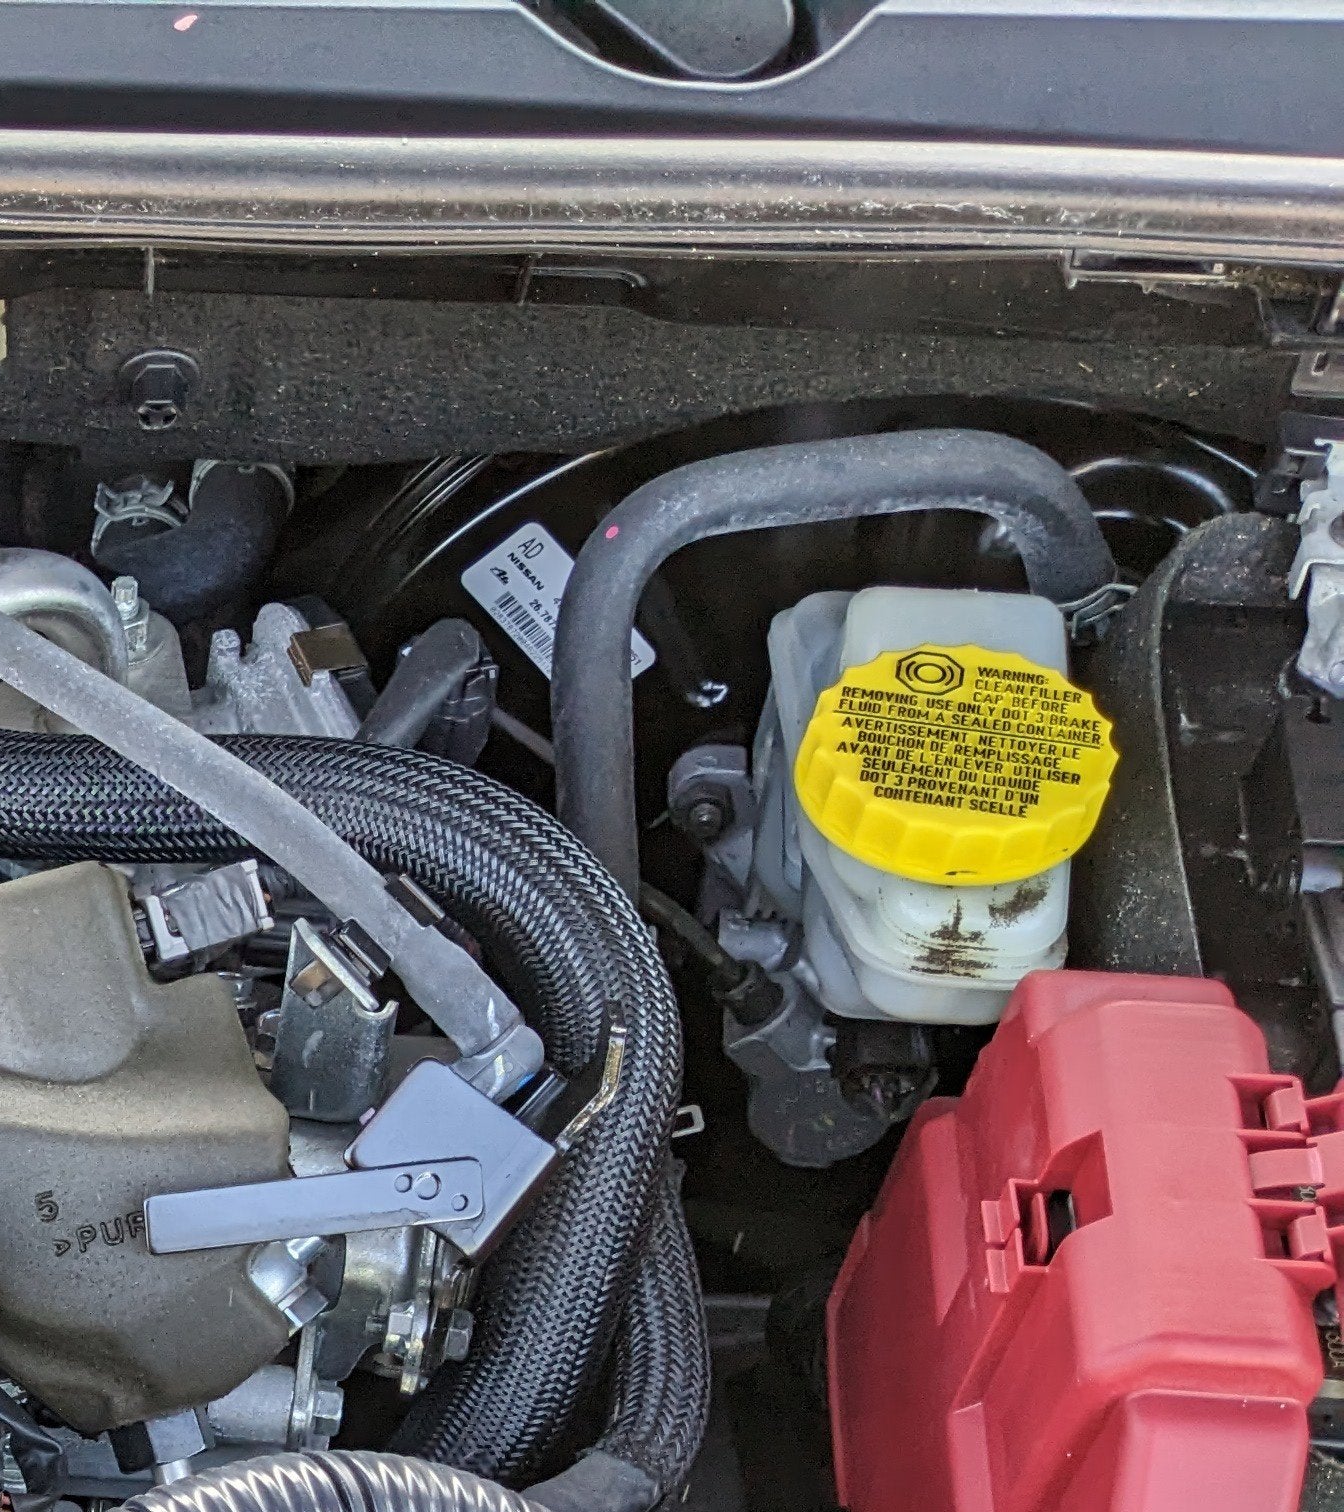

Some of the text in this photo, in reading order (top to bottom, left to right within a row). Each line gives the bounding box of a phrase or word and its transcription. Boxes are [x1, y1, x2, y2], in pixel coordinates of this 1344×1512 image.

[518, 537, 544, 560] AD
[507, 552, 545, 591] NISSAN
[973, 692, 1068, 714] CAP BEFORE
[975, 679, 1082, 703] CLEAN FILLER
[839, 699, 881, 713] FLUID
[888, 705, 930, 720] FROM
[935, 711, 944, 722] A
[951, 714, 1011, 732] SEALED
[842, 686, 1100, 731] REMOVING USE ONLY DOT 3 BRAKE
[837, 742, 1081, 785] AVANT DE L'ENLEVER UTILISER
[858, 731, 1061, 769] BOUCHON DE REMPLISSAGE
[979, 735, 1057, 756] NETTOYER
[1063, 747, 1081, 759] LE
[860, 770, 1039, 805] DOT 3 PROVENANT D'UN
[863, 758, 1040, 792] SEULEMENT DU LIQUIDE
[873, 786, 963, 809] CONTENANT
